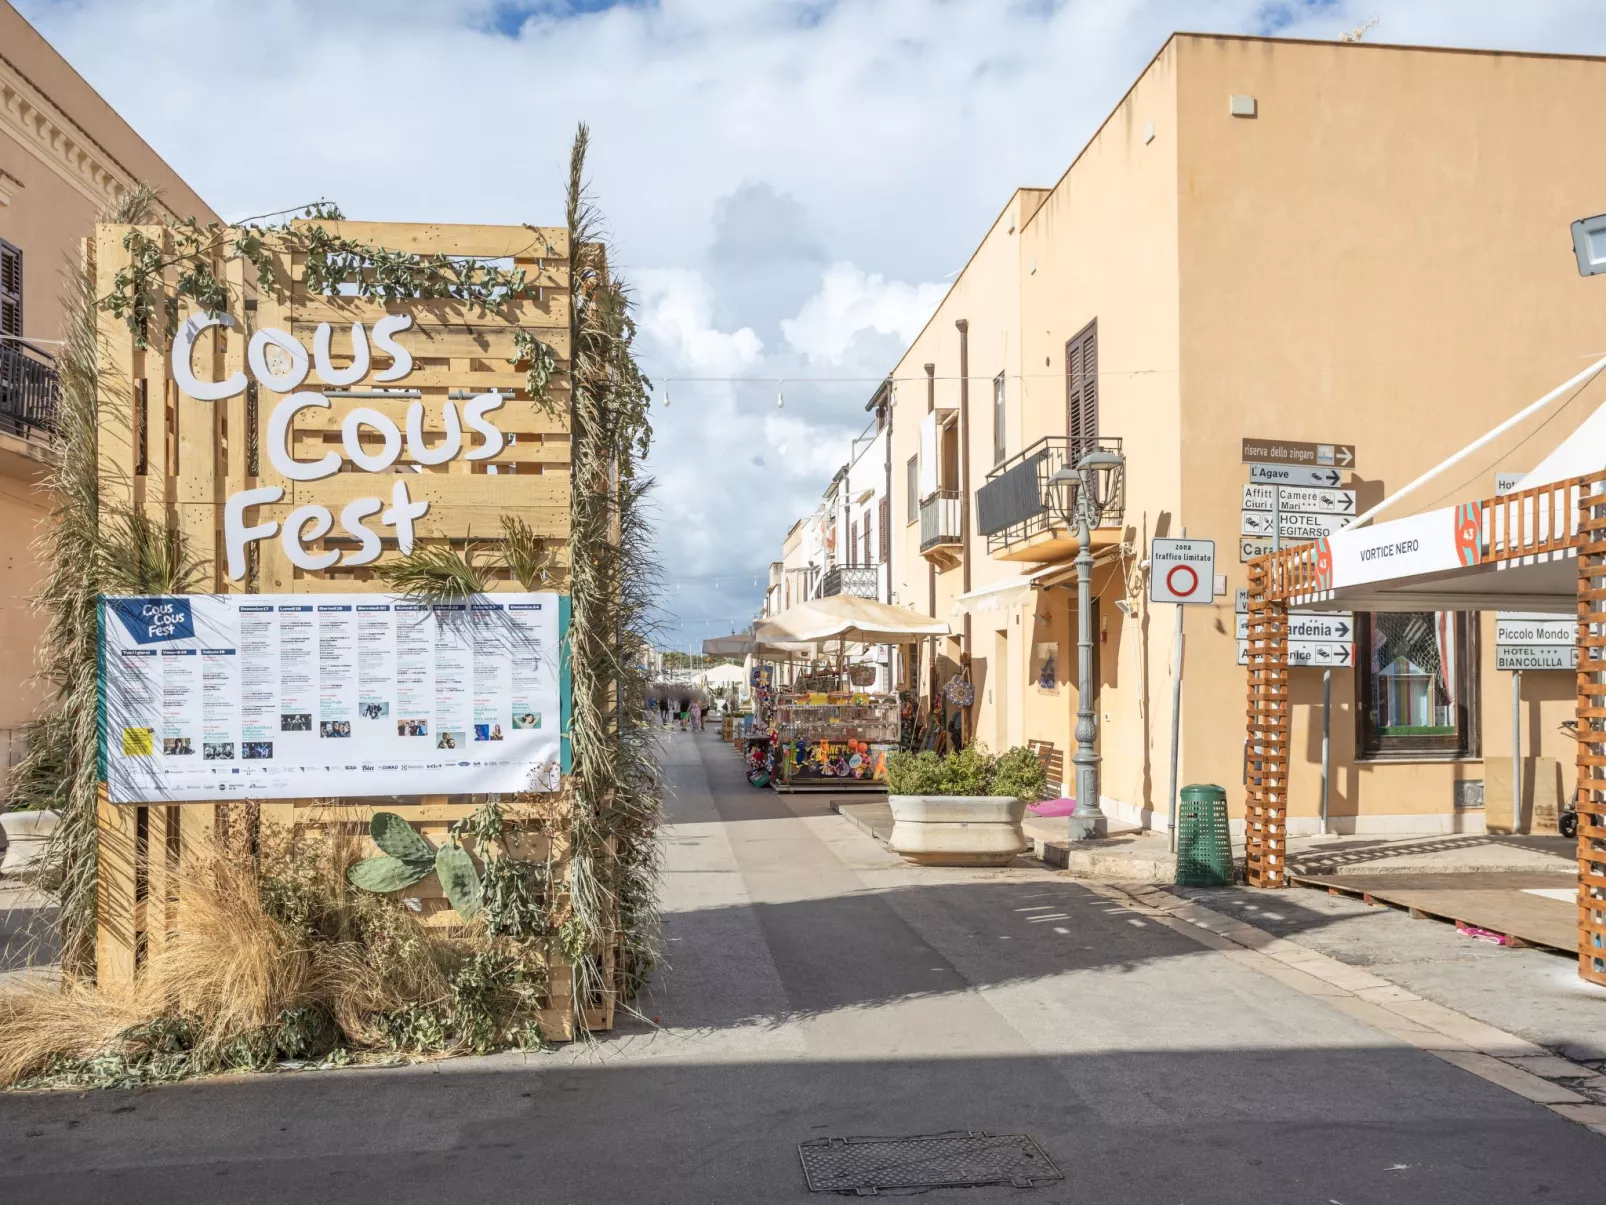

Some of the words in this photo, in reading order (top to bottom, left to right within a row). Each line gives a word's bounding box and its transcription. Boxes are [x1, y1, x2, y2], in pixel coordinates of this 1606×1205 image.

[171, 311, 413, 401] Cous
[266, 391, 504, 481] Cous
[1244, 444, 1267, 456] riserva
[1270, 445, 1288, 458] dello
[1289, 448, 1314, 461] zingaro
[1251, 466, 1289, 479] L'Agave
[1245, 488, 1272, 499] Affitt
[1280, 490, 1318, 501] Camere
[1245, 500, 1269, 508] Ciuri
[1280, 515, 1321, 526] HOTEL
[224, 480, 430, 581] Fest
[1280, 526, 1330, 537] EGITARSO
[1463, 528, 1474, 541] 43
[1155, 552, 1182, 561] traffico
[1183, 552, 1211, 562] limitato
[1360, 544, 1395, 562] VORTICE
[1395, 539, 1419, 555] NERO
[142, 603, 173, 617] Cous
[153, 612, 185, 626] Cous
[148, 625, 175, 638] Fest
[1498, 628, 1534, 640] Piccolo
[1536, 628, 1569, 640] Mondo
[1503, 648, 1536, 656] HOTEL
[1498, 657, 1563, 667] BIANCOLILLA
